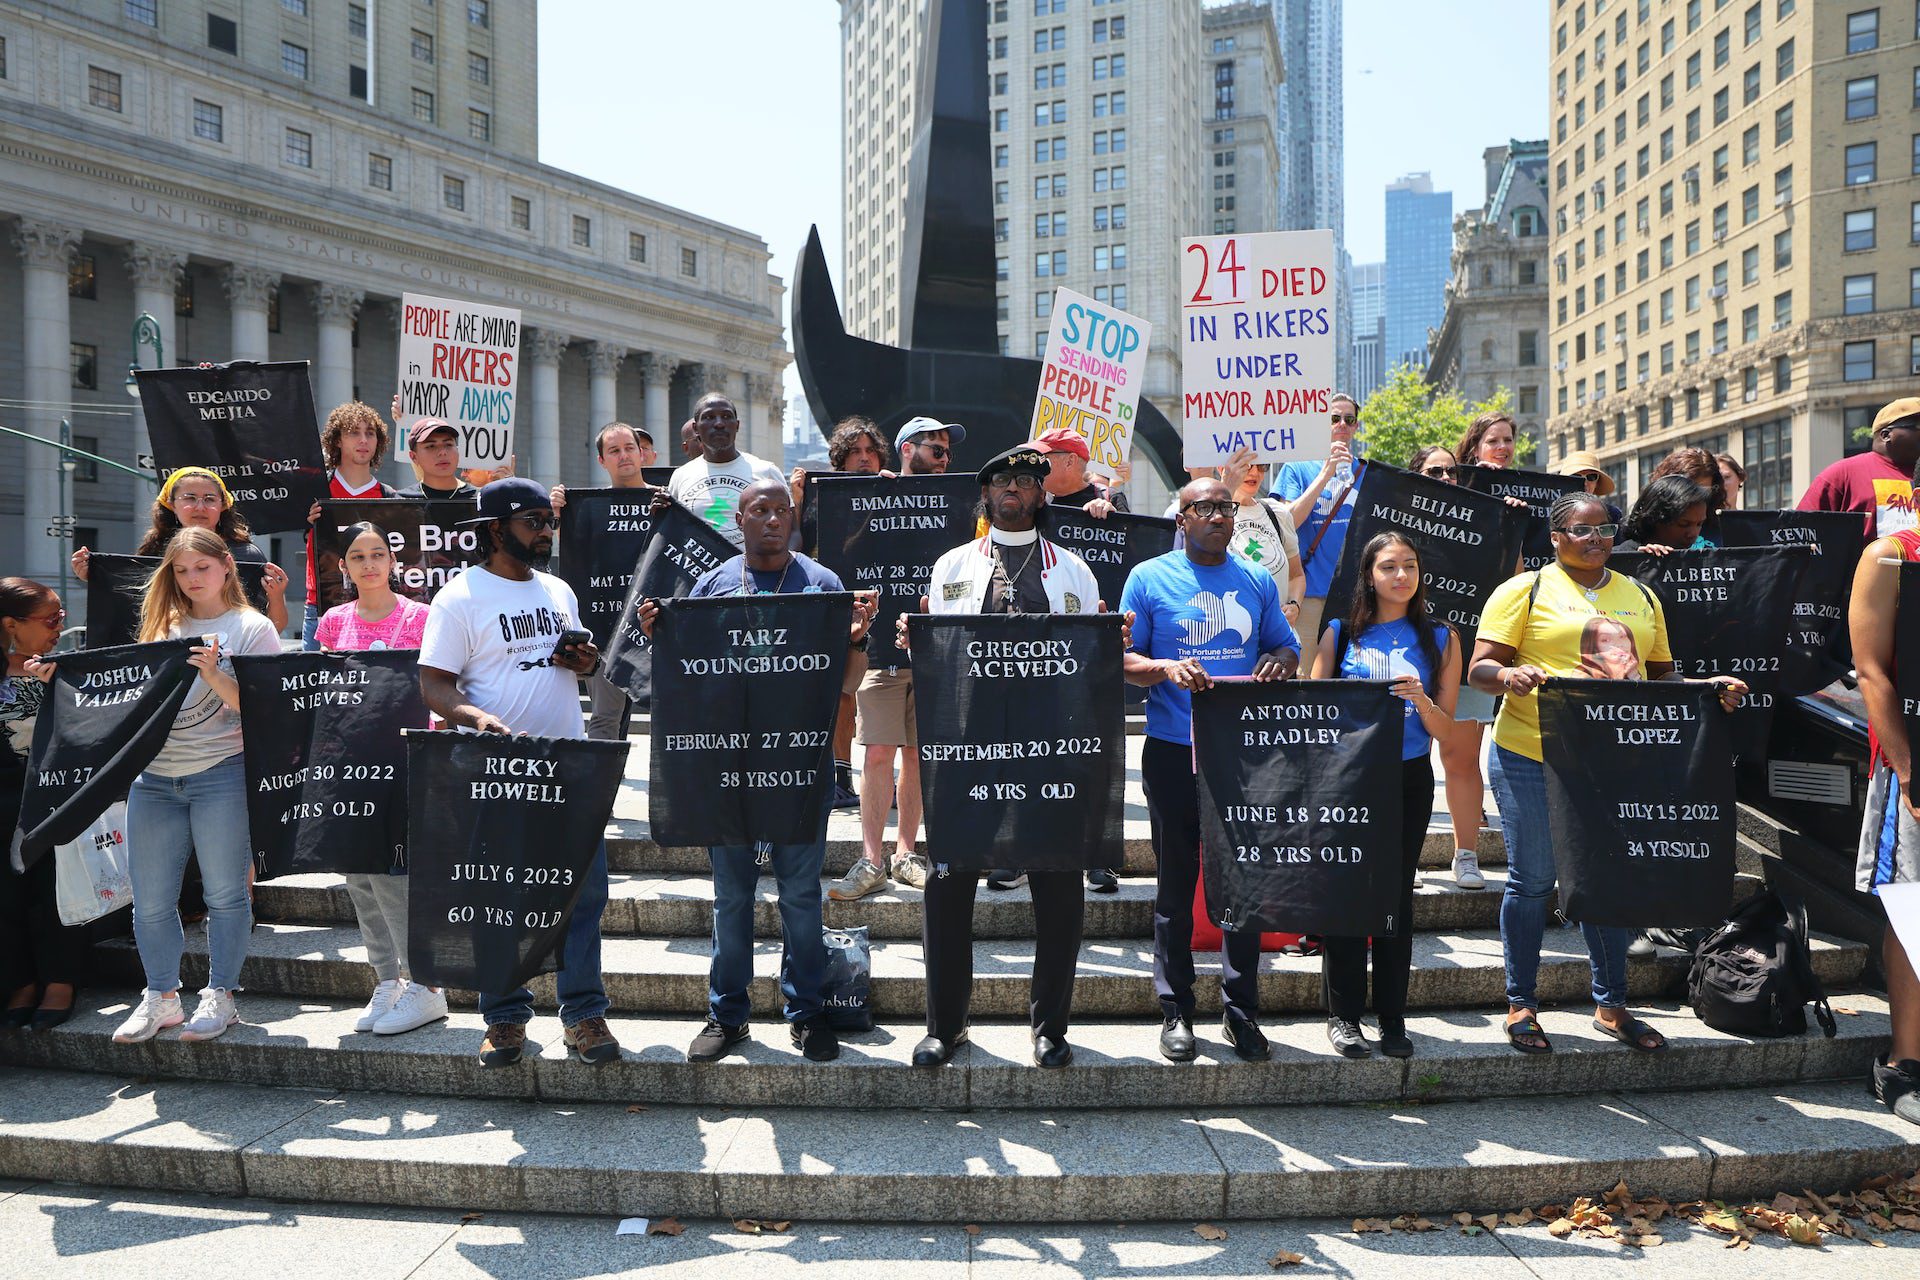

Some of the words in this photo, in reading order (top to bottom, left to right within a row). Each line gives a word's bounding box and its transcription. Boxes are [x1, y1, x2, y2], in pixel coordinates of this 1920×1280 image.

[131, 196, 249, 237] UNITED
[287, 235, 374, 267] STATES
[401, 263, 481, 292] COURT
[505, 286, 571, 313] HOUSE
[1187, 239, 1245, 303] 24
[1262, 267, 1326, 298] DIED
[405, 305, 450, 339] PEOPLE
[454, 312, 478, 343] ARE
[481, 317, 516, 348] DYING
[1062, 303, 1139, 363] STOP
[1189, 315, 1217, 342] IN
[1234, 308, 1329, 340] RIKERS
[409, 362, 421, 375] in
[432, 343, 513, 386] RIKERS
[1059, 346, 1127, 385] SENDING
[1217, 353, 1302, 379] UNDER
[187, 388, 272, 404] EDGARDO
[401, 380, 449, 418] MAYOR
[460, 387, 512, 424] ADAMS
[1043, 363, 1115, 414] PEOPLE
[1117, 402, 1133, 421] TO
[199, 406, 256, 421] MEJIA
[1185, 390, 1255, 418] MAYOR
[461, 426, 508, 461] YOU
[1213, 428, 1295, 453] WATCH
[240, 464, 254, 476] 11
[263, 458, 300, 475] 2022
[232, 490, 257, 502] YRS
[262, 487, 289, 500] OLD
[1491, 484, 1561, 500] DASHAWN
[851, 495, 949, 511] EMMANUEL
[1411, 494, 1474, 523] ELIJAH
[607, 520, 650, 531] ZHAO
[869, 515, 947, 532] SULLIVAN
[1371, 504, 1483, 547] MUHAMMAD
[419, 524, 478, 551] Bro
[1058, 525, 1127, 545] GEORGE
[1770, 528, 1817, 542] KEVIN
[663, 544, 707, 581] TAVE
[683, 537, 724, 569] FELI
[590, 575, 613, 588] MAY
[620, 575, 633, 587] 17
[856, 566, 884, 580] MAY
[890, 565, 905, 578] 28
[912, 565, 935, 578] 202
[1662, 567, 1737, 583] ALBERT
[890, 583, 916, 596] YRS
[1423, 573, 1433, 585] 0
[1436, 576, 1477, 597] 2022
[1677, 587, 1728, 603] DRYE
[591, 601, 605, 613] 52
[608, 600, 623, 612] YR
[1792, 603, 1816, 616] BER
[499, 613, 512, 642] 8
[511, 610, 535, 639] min
[536, 607, 552, 636] 46
[1448, 610, 1480, 627] OLD
[621, 621, 648, 647] YRS
[728, 629, 787, 646] TARZ
[966, 640, 1073, 659] GREGORY
[1193, 648, 1221, 656] Fortune
[1222, 647, 1245, 655] Society
[680, 654, 830, 675] YOUNGBLOOD
[968, 658, 1078, 678] ACEVEDO
[1696, 659, 1720, 673] 21
[1731, 657, 1780, 672] 2022
[79, 665, 152, 689] JOSHUA
[281, 669, 371, 692] MICHAEL
[74, 685, 144, 708] VALLES
[292, 691, 364, 712] NIEVES
[1240, 704, 1340, 721] ANTONIO
[1584, 704, 1696, 721] MICHAEL
[665, 733, 750, 751] FEBRUARY
[761, 732, 781, 749] 27
[789, 731, 829, 748] 2022
[1244, 728, 1341, 747] BRADLEY
[1616, 727, 1681, 745] LOPEZ
[921, 743, 1025, 761] SEPTEMBER
[1027, 740, 1050, 757] 20
[1056, 738, 1101, 755] 2022
[38, 769, 67, 787] MAY
[73, 767, 93, 783] 27
[312, 765, 335, 780] 30
[343, 765, 394, 780] 2022
[485, 757, 559, 778] RICKY
[720, 771, 740, 788] 38
[470, 782, 566, 803] HOWELL
[969, 784, 988, 800] 48
[994, 783, 1027, 800] YRS
[1041, 782, 1076, 799] OLD
[293, 802, 324, 820] YRS
[332, 801, 376, 817] OLD
[1224, 806, 1277, 823] JUNE
[1286, 806, 1309, 822] 18
[1319, 806, 1369, 823] 2022
[1618, 803, 1654, 820] JULY
[1656, 804, 1677, 820] 15
[1681, 804, 1720, 820] 2022
[1236, 846, 1260, 862] 28
[1273, 846, 1312, 864] YRS
[1320, 846, 1363, 863] OLD
[1627, 841, 1644, 857] 34
[451, 864, 500, 882] JULY
[505, 867, 514, 883] 6
[523, 867, 573, 885] 2023
[447, 905, 474, 923] 60
[484, 906, 514, 927] YRS
[525, 911, 561, 928] OLD
